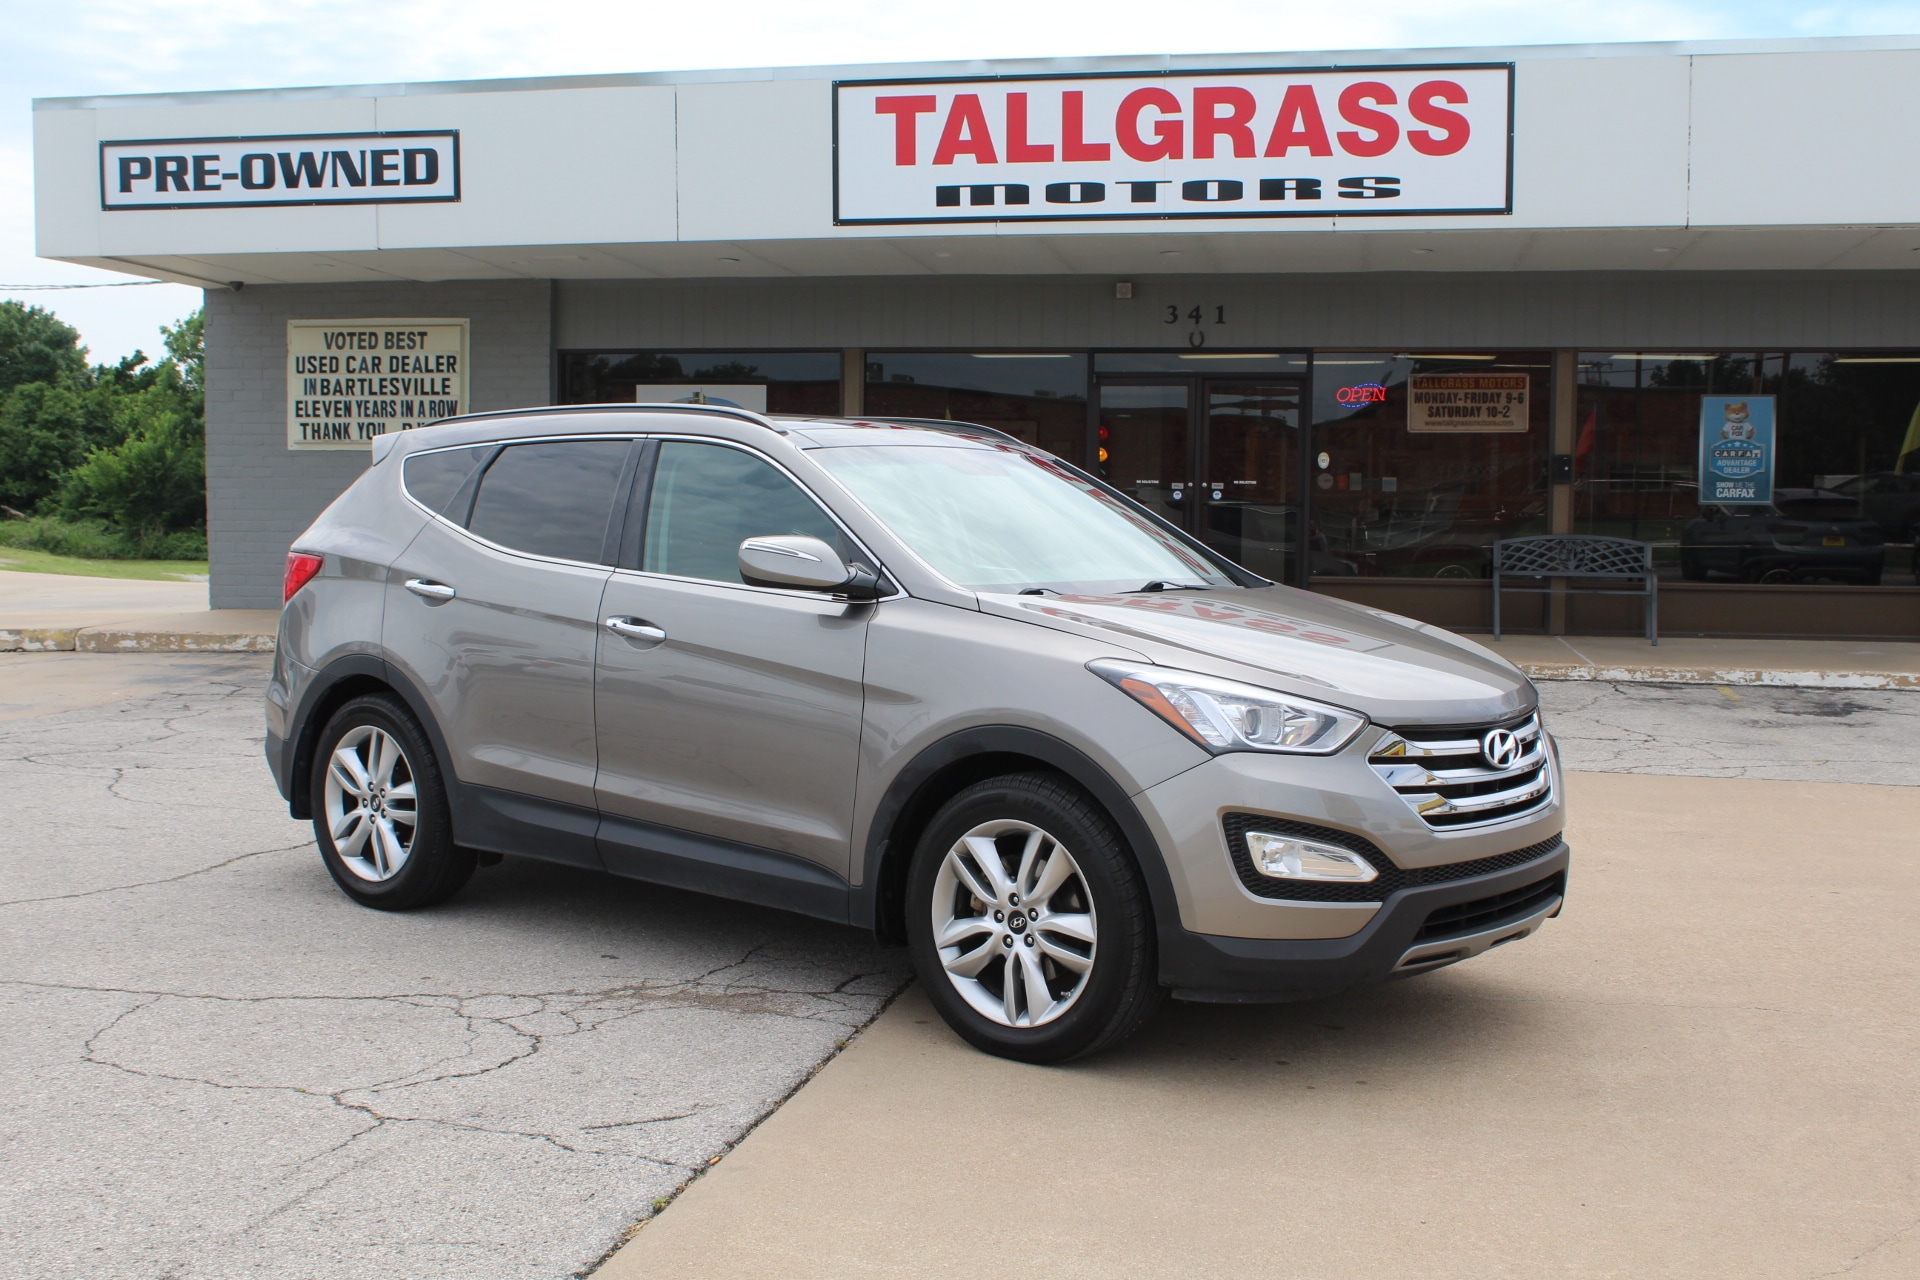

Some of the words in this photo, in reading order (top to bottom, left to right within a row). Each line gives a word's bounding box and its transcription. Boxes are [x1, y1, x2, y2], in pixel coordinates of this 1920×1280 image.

[875, 80, 1471, 167] TALLGRASS
[118, 148, 439, 193] PRE-OWNED
[935, 177, 1401, 207] MOTORS
[1164, 304, 1226, 325] 341
[324, 332, 379, 350] VOTED
[384, 331, 428, 350] BEST
[295, 356, 339, 374] USED
[346, 356, 382, 374] CAR
[389, 355, 457, 374] DEALER
[304, 378, 317, 396] IN
[320, 377, 451, 396] BARTLESVILLE
[1415, 378, 1475, 389] TALLGRASS
[1479, 378, 1524, 388] MOTORS
[1336, 387, 1387, 402] OPEN
[1414, 392, 1502, 404] MONDAY-FRIDAY
[1505, 392, 1525, 404] 9-6
[295, 400, 352, 418] ELEVEN
[355, 400, 397, 418] YEARS
[401, 400, 414, 418] IN
[417, 400, 426, 418] A
[429, 400, 458, 417] ROW
[1427, 405, 1482, 418] SATURDAY
[1485, 405, 1511, 418] 10-2
[300, 422, 351, 440] THANK
[1714, 450, 1760, 458] CARFAX
[1716, 488, 1754, 498] CARFAX
